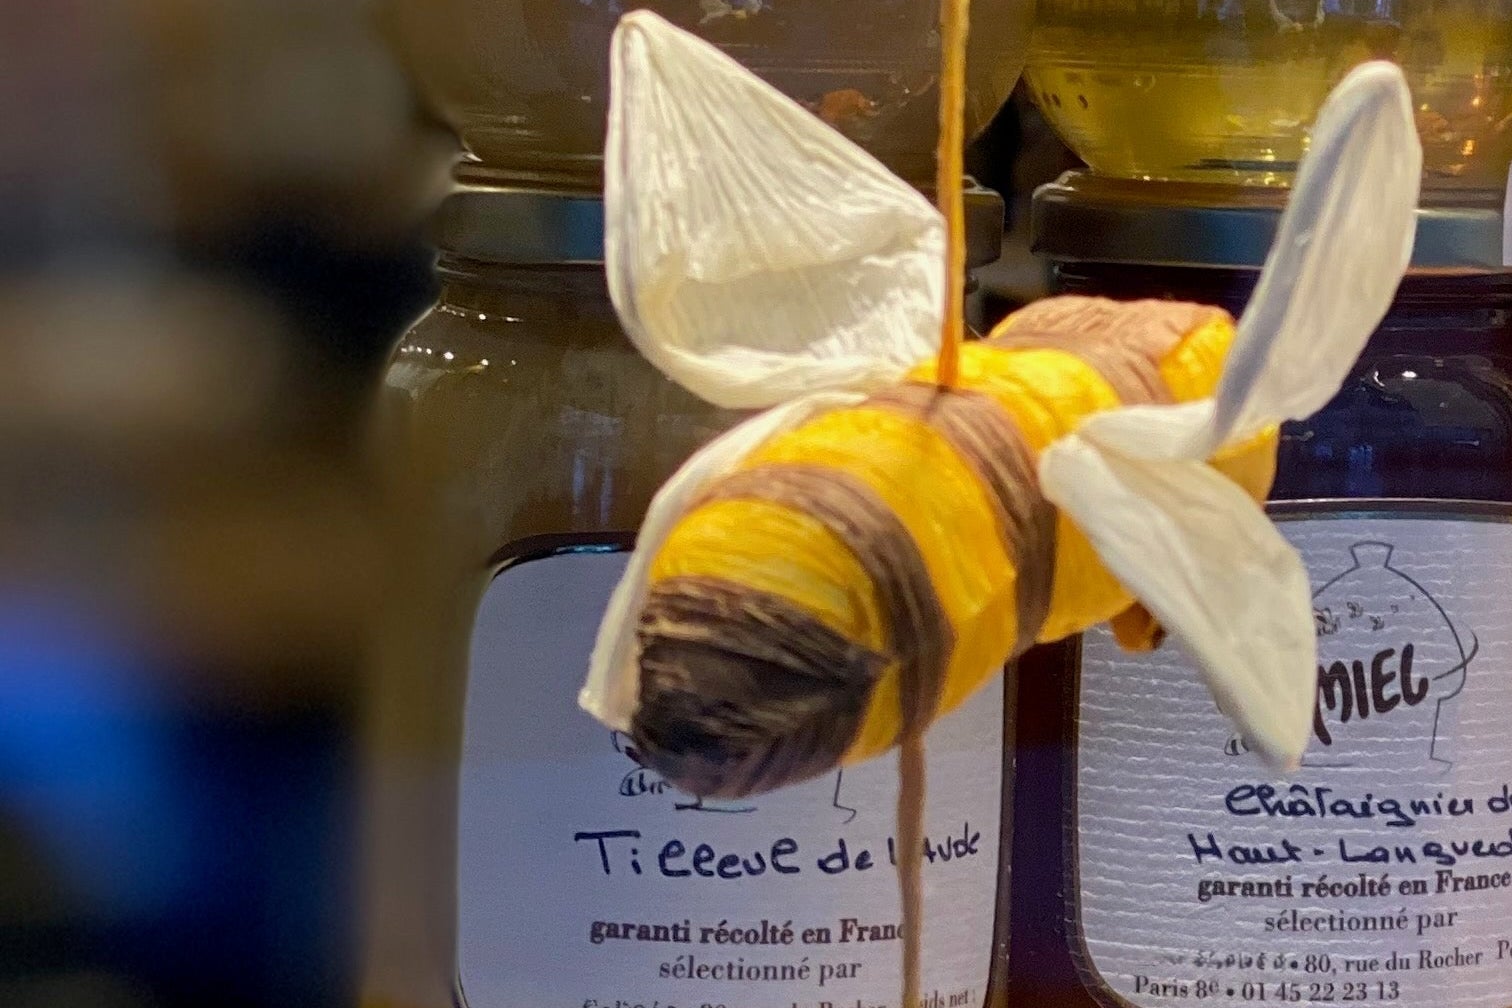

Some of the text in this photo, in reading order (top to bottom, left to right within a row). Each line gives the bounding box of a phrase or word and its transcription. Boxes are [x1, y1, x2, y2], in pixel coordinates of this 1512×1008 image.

[1314, 643, 1429, 746] MIEL
[818, 839, 873, 874] de
[1198, 869, 1511, 902] garanti récolté en France
[590, 920, 690, 945] garanti
[700, 921, 793, 944] récolté
[802, 928, 831, 944] en
[1265, 908, 1457, 940] sélectionné par
[659, 956, 861, 986] sélectionné par
[1344, 956, 1378, 972] rue
[1386, 950, 1411, 970] du
[1419, 948, 1483, 969] Rocher
[1134, 975, 1400, 1002] Paris 01 45 22 23 13
